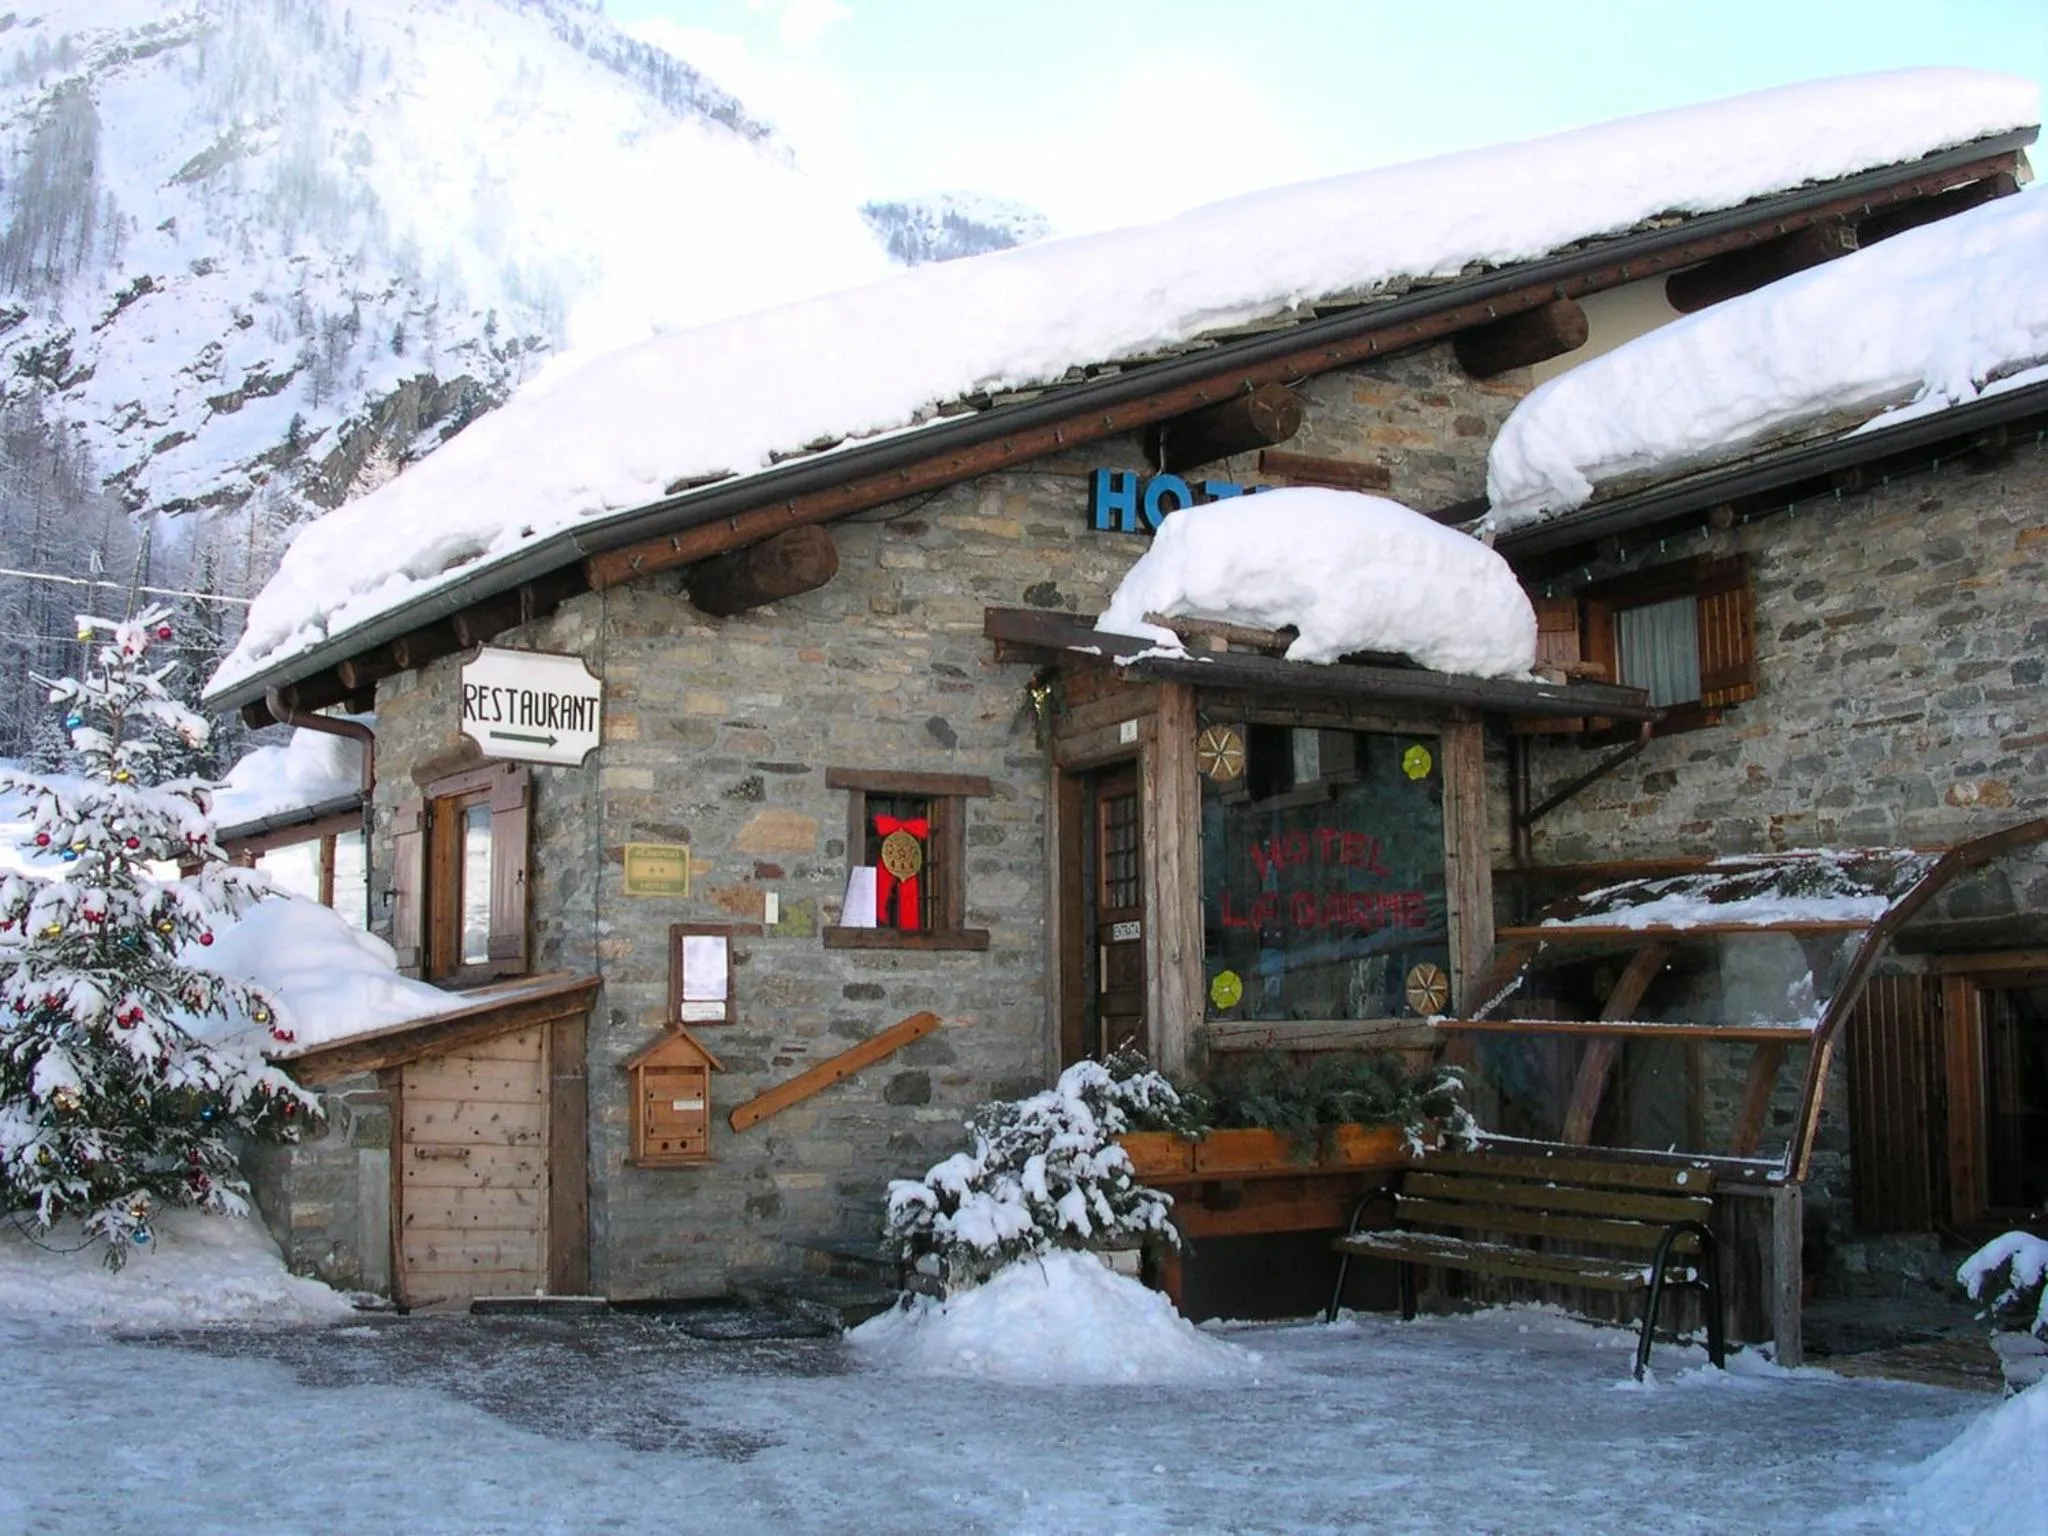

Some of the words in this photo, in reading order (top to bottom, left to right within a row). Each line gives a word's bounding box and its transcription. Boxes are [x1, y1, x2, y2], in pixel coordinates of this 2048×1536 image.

[463, 683, 599, 733] RESTAURANT
[1249, 827, 1391, 881] HOTEL
[1220, 888, 1280, 930] LA
